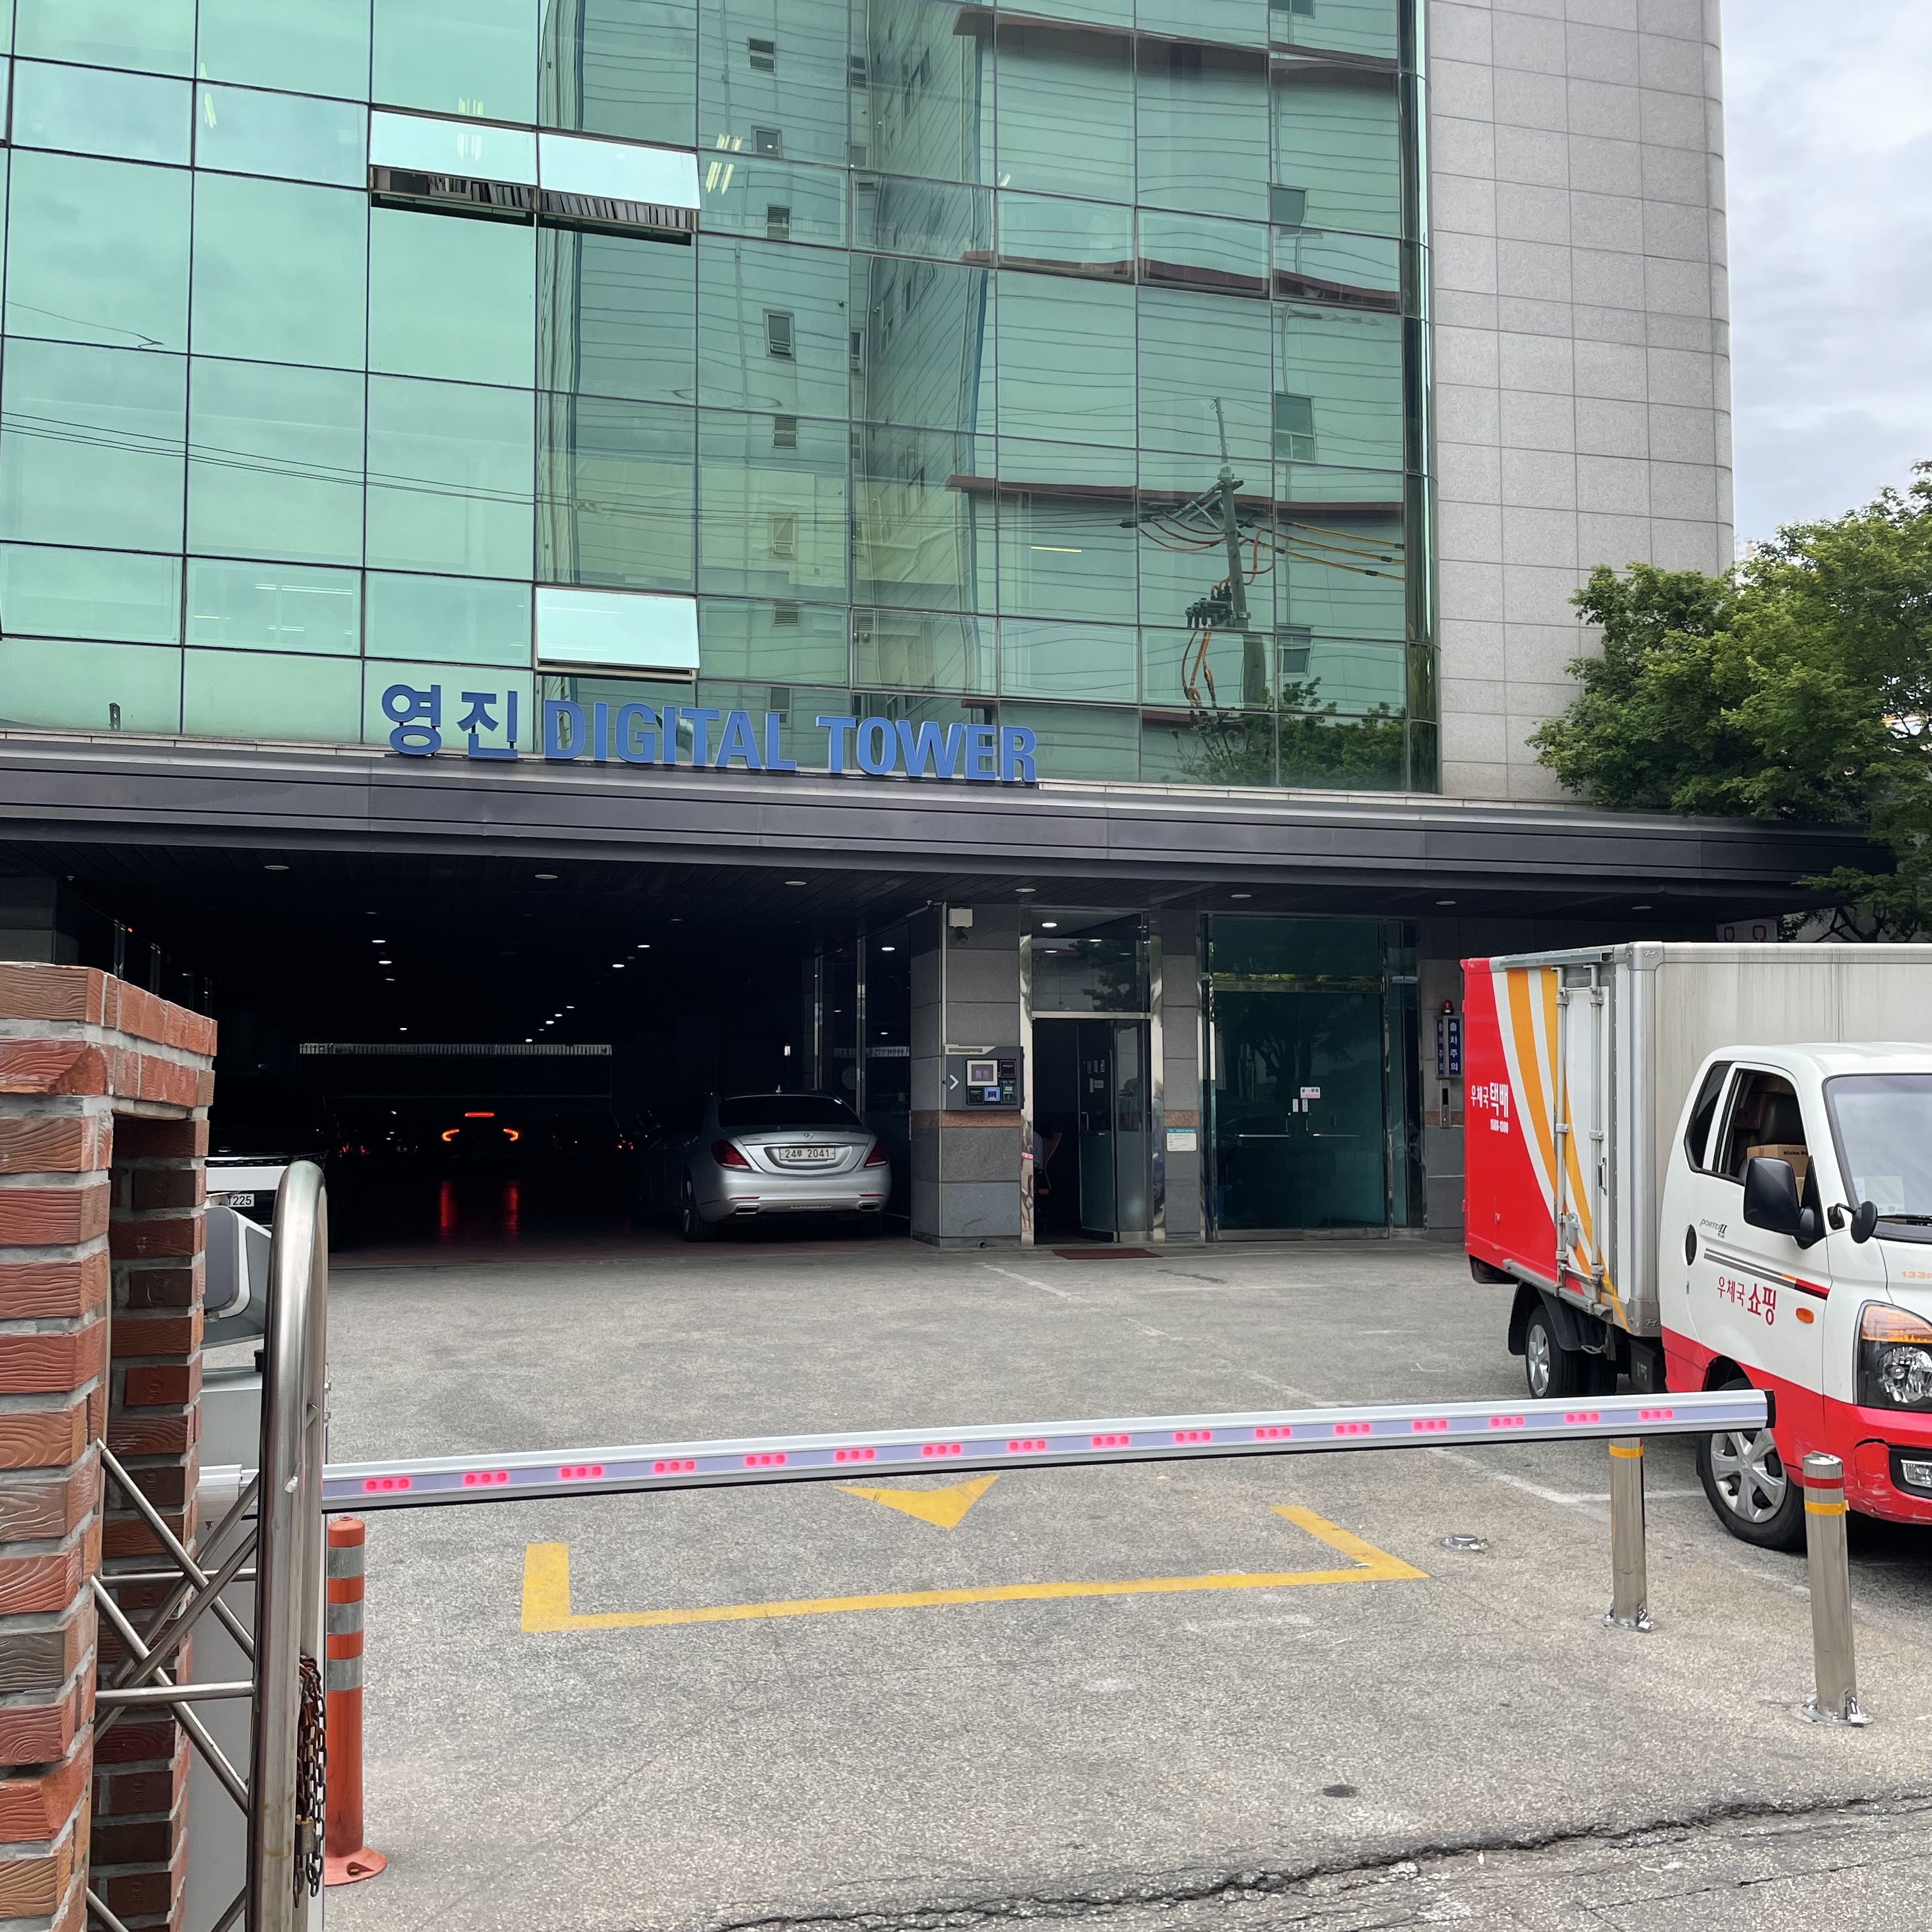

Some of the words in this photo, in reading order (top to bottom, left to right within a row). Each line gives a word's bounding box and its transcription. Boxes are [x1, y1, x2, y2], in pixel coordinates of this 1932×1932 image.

[381, 684, 518, 760] 영진
[544, 700, 797, 770] DIGITAL
[816, 716, 1036, 783] TOWER
[1471, 1084, 1489, 1109] 우체국
[1489, 1082, 1509, 1119] 택배
[807, 1149, 829, 1158] 2041
[1717, 1276, 1745, 1307] 우체국
[1747, 1283, 1777, 1326] 쇼핑
